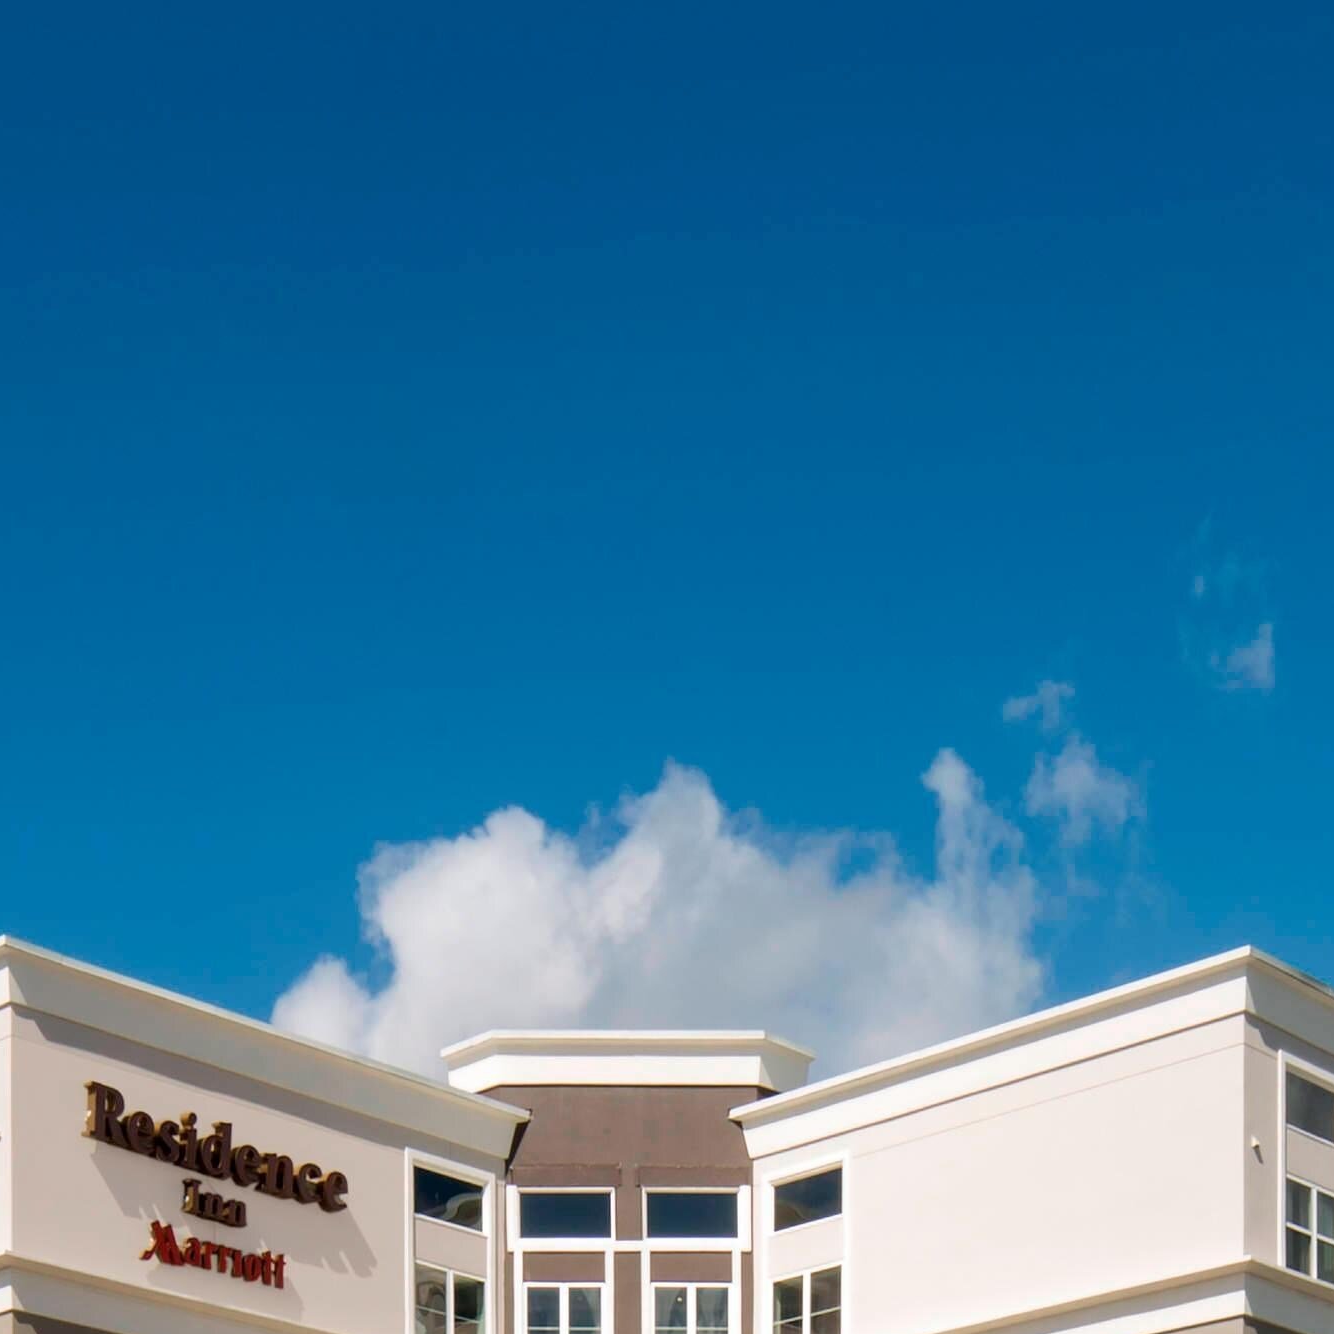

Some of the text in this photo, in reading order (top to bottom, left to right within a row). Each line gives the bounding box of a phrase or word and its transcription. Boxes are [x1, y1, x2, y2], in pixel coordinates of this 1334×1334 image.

[81, 1081, 349, 1213] Residence
[181, 1178, 247, 1228] Inn
[139, 1220, 286, 1289] Marriott
